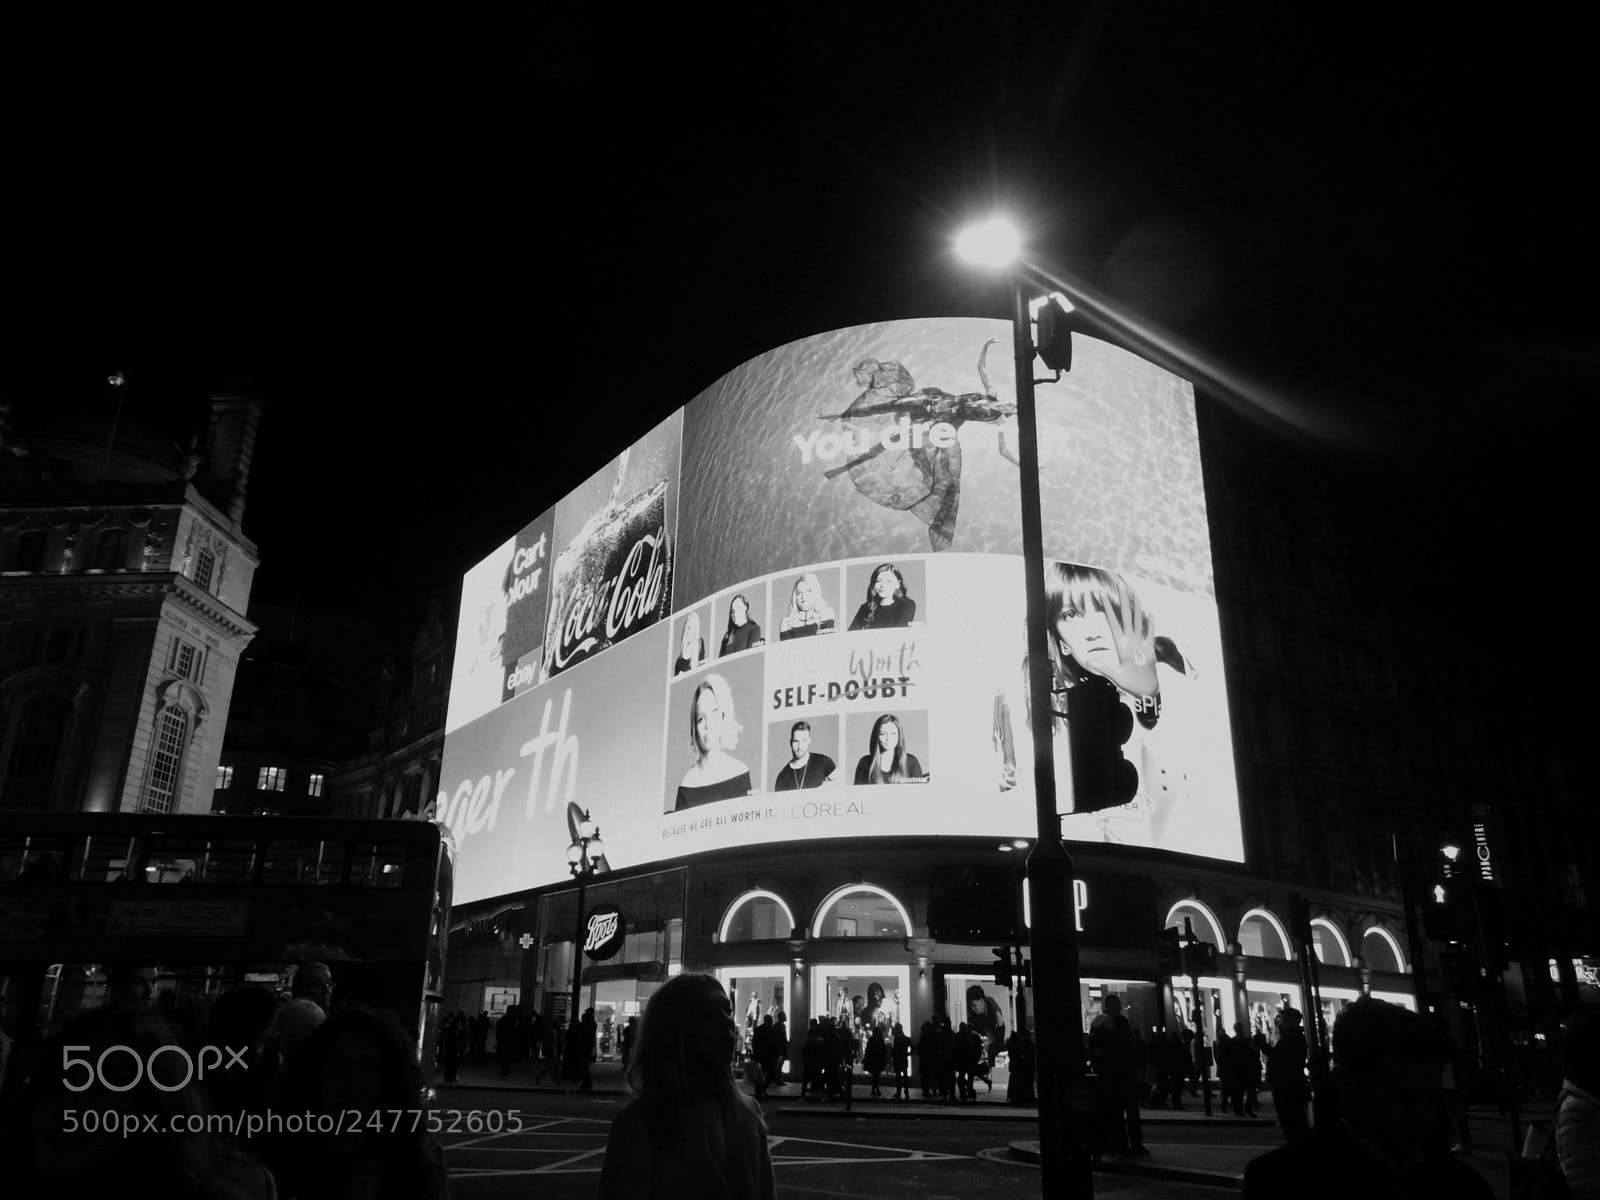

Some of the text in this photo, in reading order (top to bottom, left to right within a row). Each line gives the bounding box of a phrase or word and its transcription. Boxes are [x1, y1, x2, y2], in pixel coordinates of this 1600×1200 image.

[792, 429, 869, 464] You
[513, 531, 547, 576] Cart
[506, 567, 541, 608] olour
[555, 526, 664, 669] Coca-Cola
[507, 660, 537, 690] ebay
[849, 642, 921, 681] Worth
[773, 676, 911, 710] SELF-DOUBT
[662, 824, 686, 839] BECAUSE
[690, 821, 697, 831] WE
[700, 818, 712, 829] ARE
[716, 816, 727, 826] ALL
[731, 810, 761, 823] WORTH
[583, 911, 618, 951] Boots
